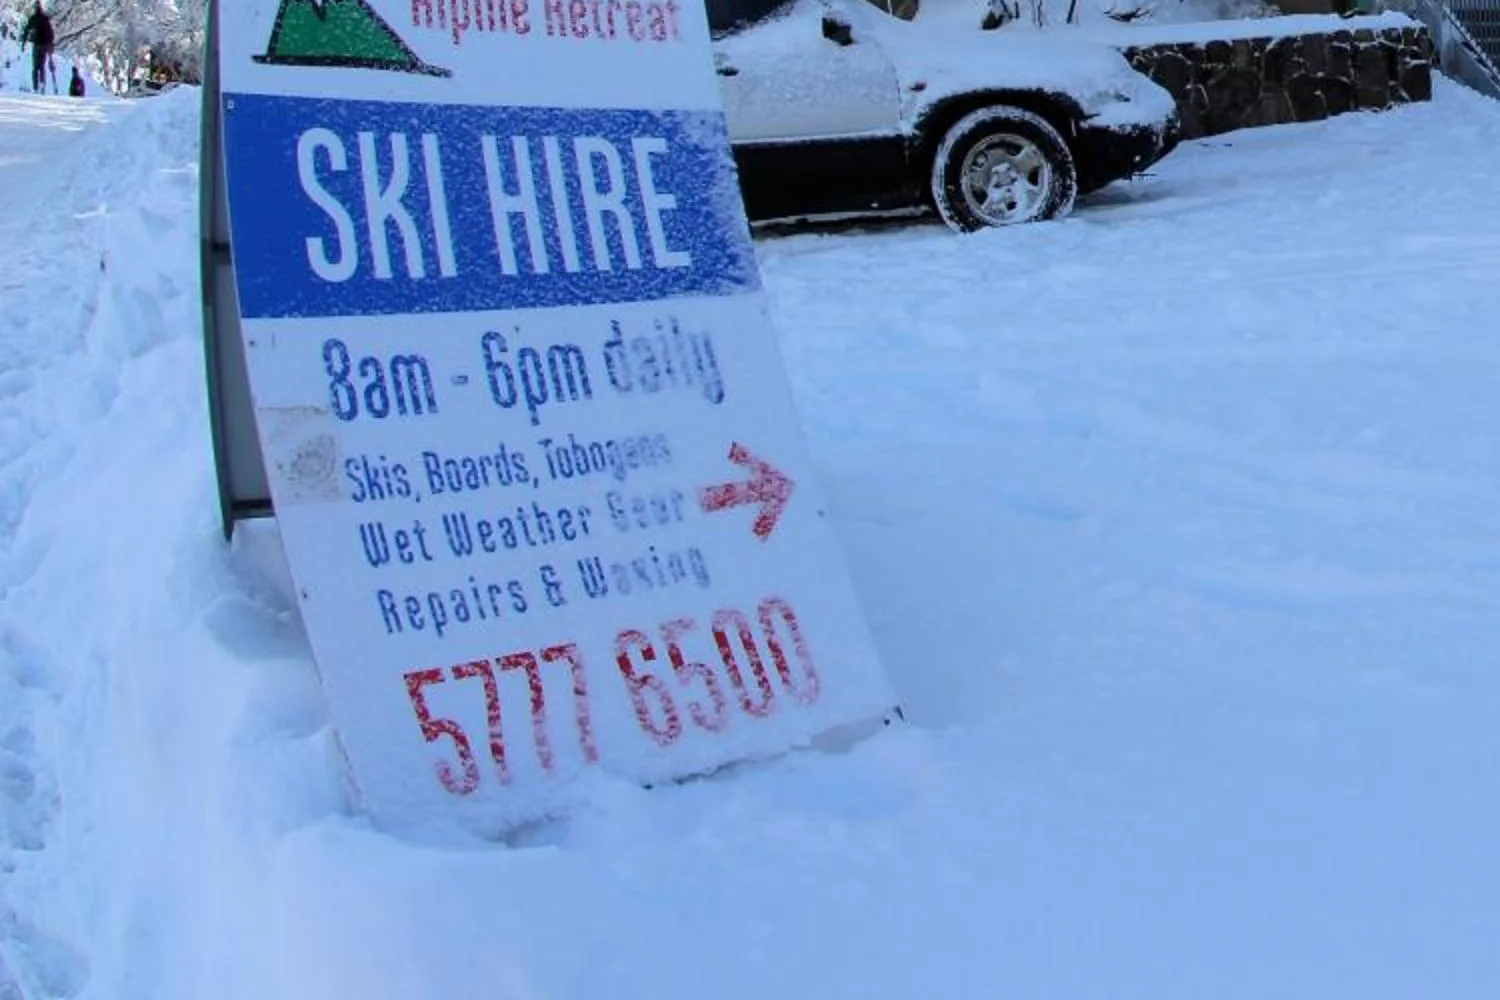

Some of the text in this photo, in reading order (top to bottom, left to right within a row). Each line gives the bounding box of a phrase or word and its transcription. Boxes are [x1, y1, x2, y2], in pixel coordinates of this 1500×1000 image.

[298, 126, 692, 284] SKI HIRE
[322, 336, 438, 422] 8am
[480, 332, 593, 425] 6pm
[603, 315, 727, 405] daily
[343, 457, 422, 506] Skis,
[423, 444, 540, 499] Boards,
[358, 489, 685, 568] Wet Weather Gear
[377, 545, 711, 639] Repairs & Waxing
[403, 596, 822, 798] 5777 6500
